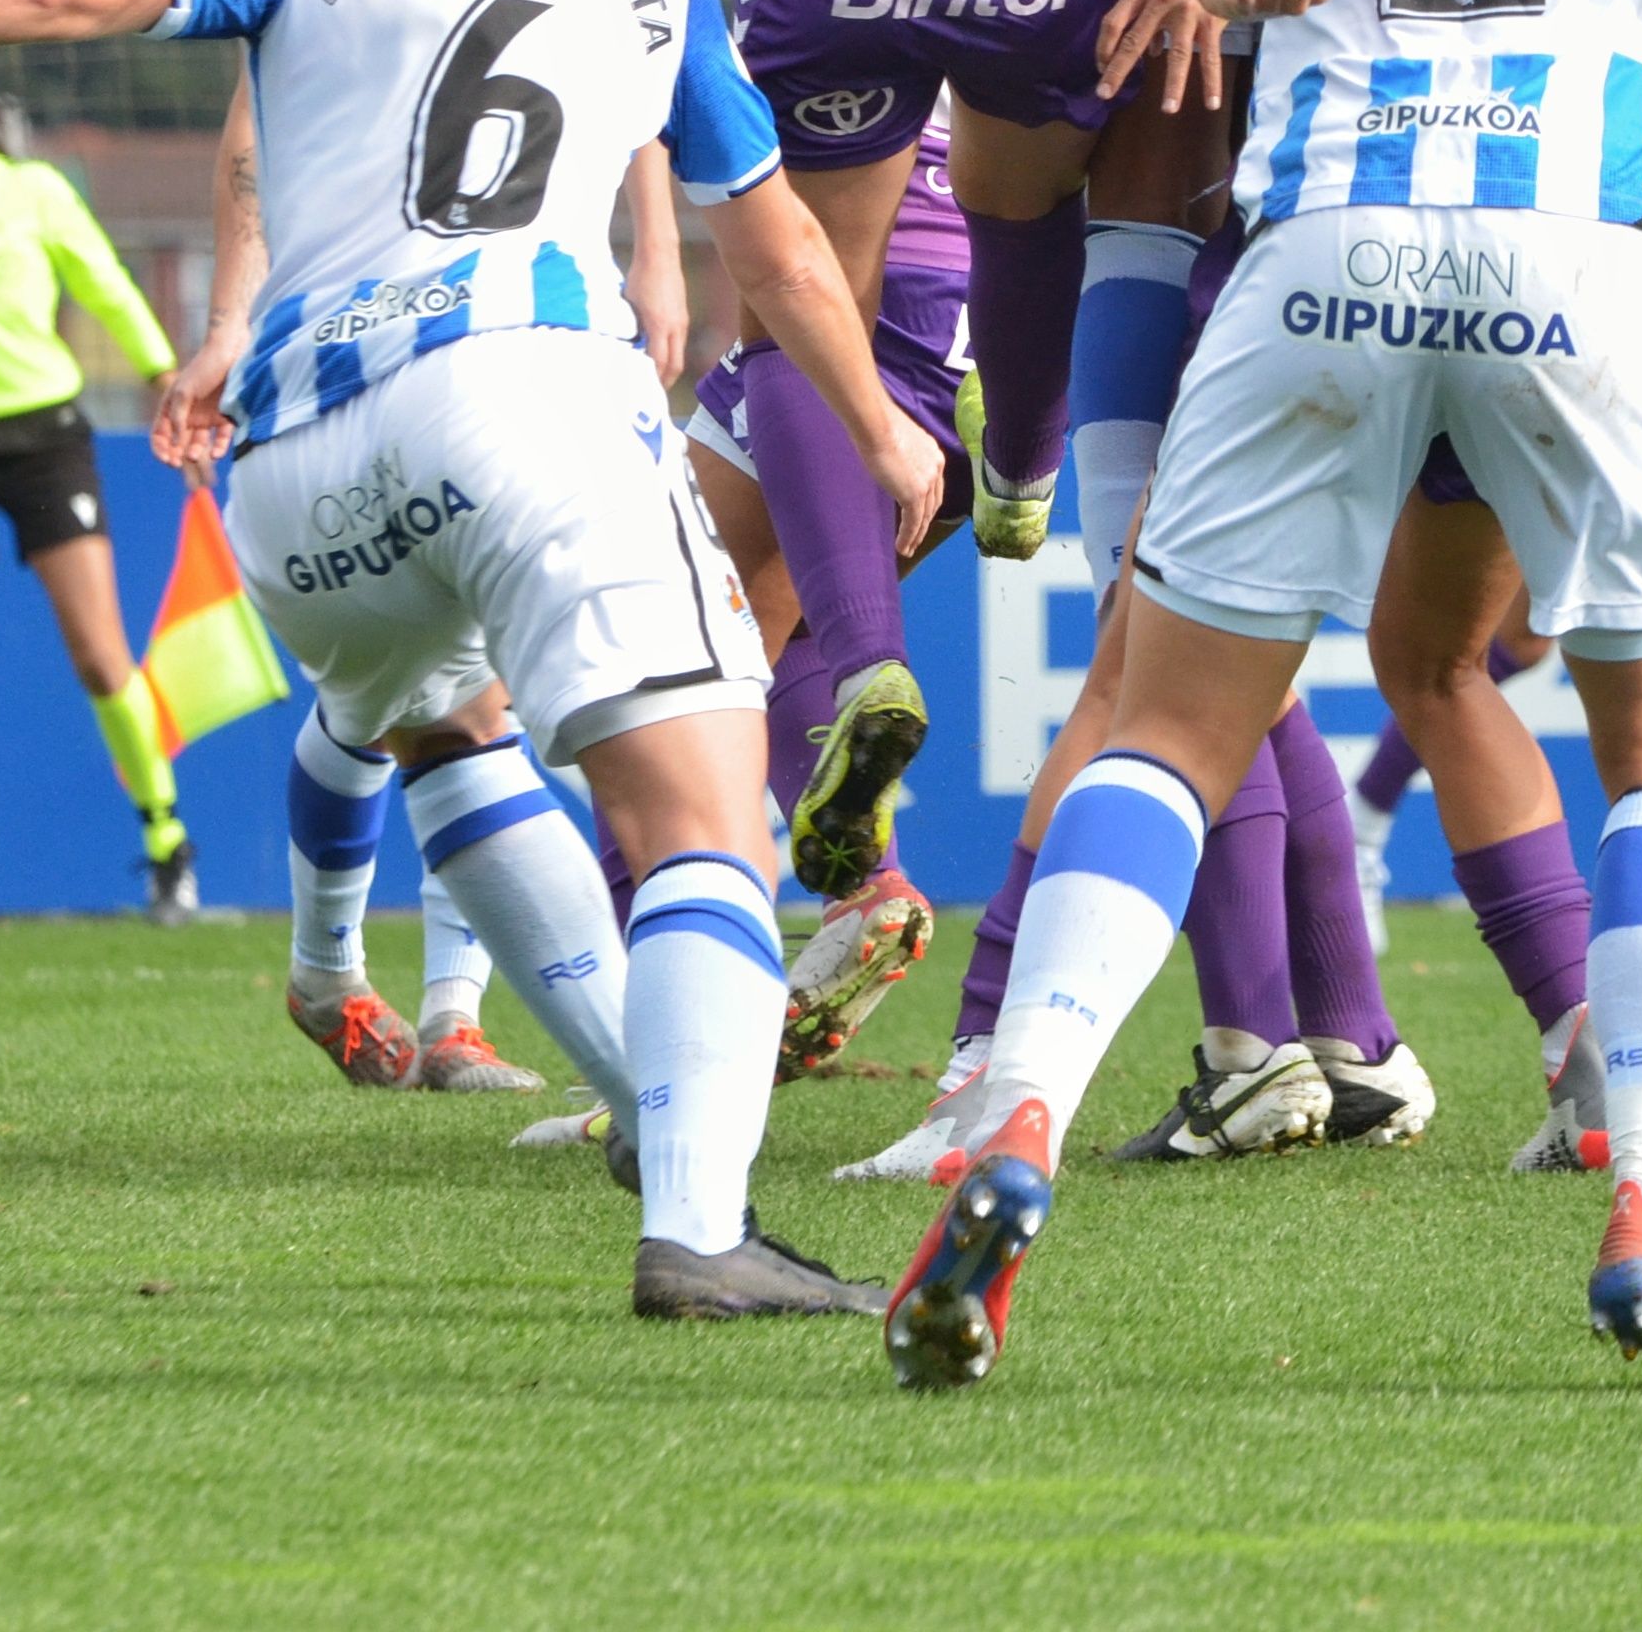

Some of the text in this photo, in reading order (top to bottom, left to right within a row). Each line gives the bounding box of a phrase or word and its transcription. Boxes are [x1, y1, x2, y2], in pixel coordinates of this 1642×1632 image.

[1357, 103, 1541, 134] GIPUZKOA
[1347, 239, 1515, 297] ORAIN
[1282, 291, 1577, 357] GIPUZKOA
[540, 950, 598, 990] RS
